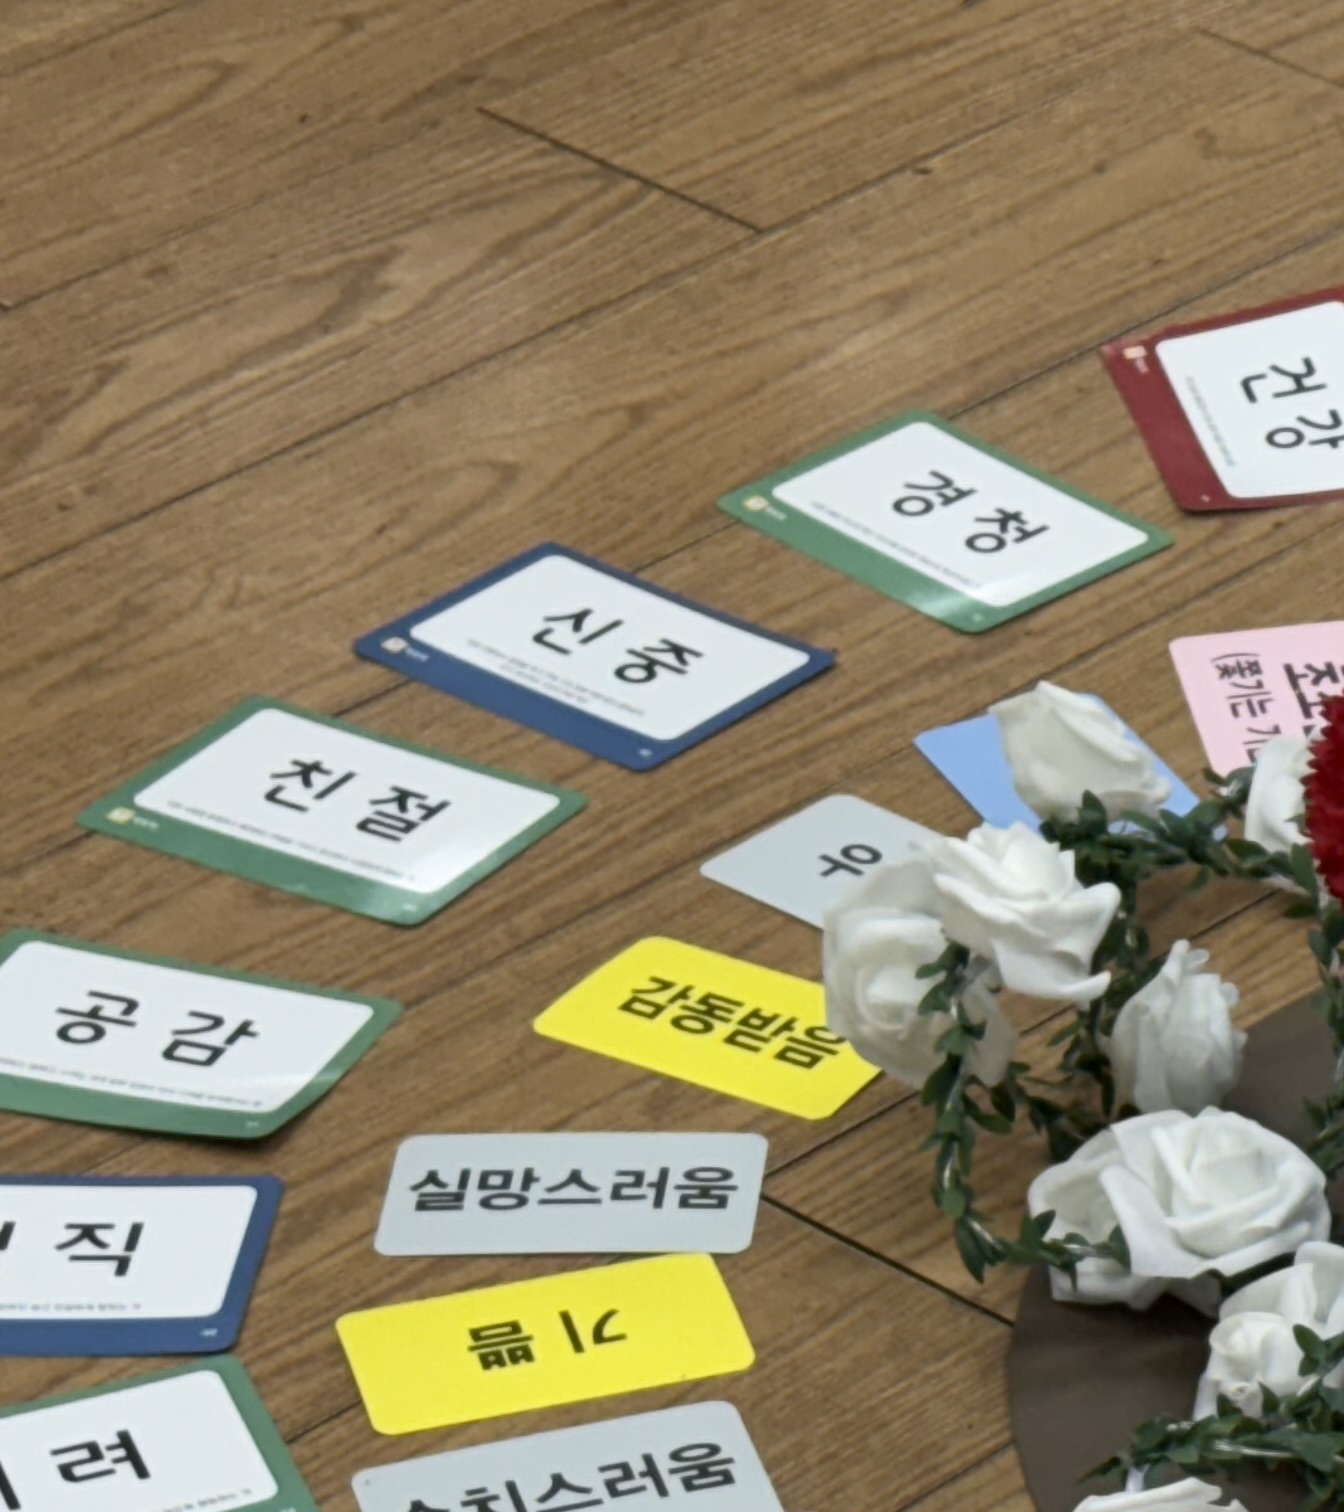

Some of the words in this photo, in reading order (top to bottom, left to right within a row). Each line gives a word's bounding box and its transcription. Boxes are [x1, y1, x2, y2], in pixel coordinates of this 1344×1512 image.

[620, 978, 847, 1069] 감동받음
[409, 1166, 738, 1213] 실망스러움
[0, 1221, 143, 1277] 직
[0, 1430, 150, 1511] 려
